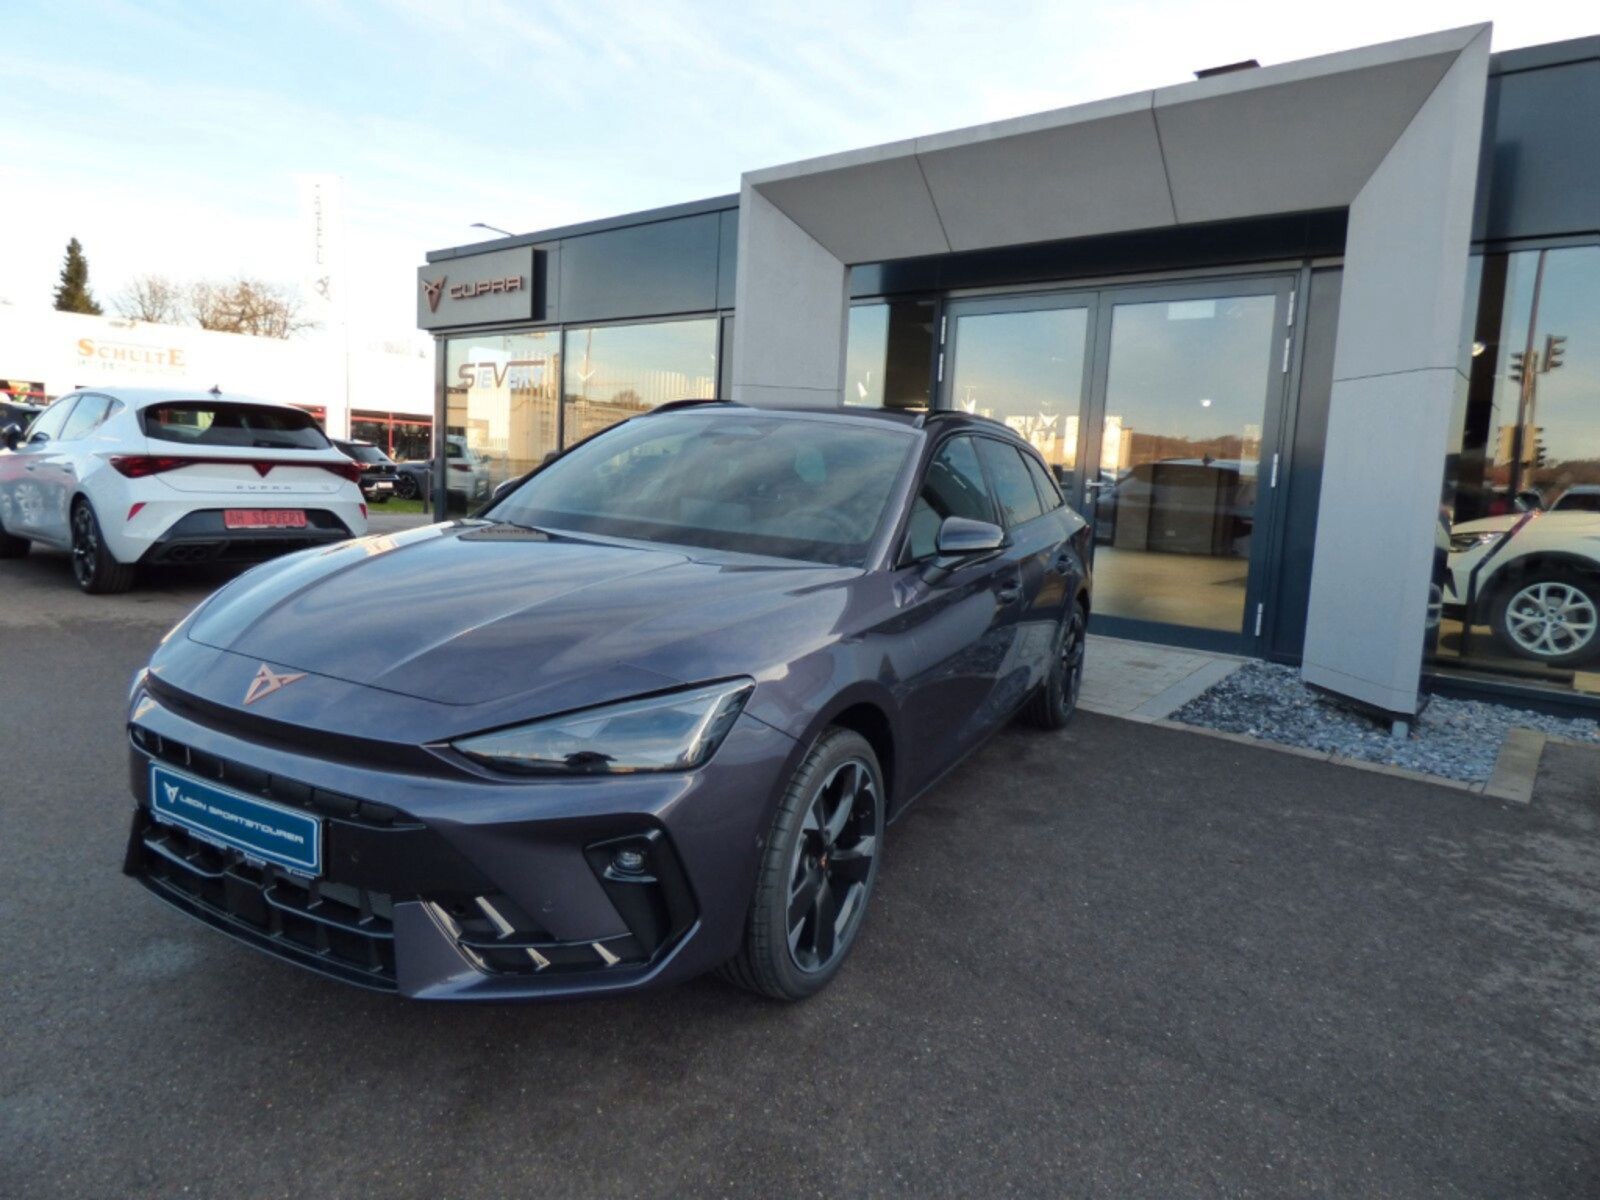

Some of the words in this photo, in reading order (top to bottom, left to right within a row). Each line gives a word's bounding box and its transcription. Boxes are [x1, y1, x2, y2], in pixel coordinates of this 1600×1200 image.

[449, 275, 524, 300] CUPRA
[179, 794, 207, 810] LEON
[209, 805, 304, 844] SPORTSTOURER
